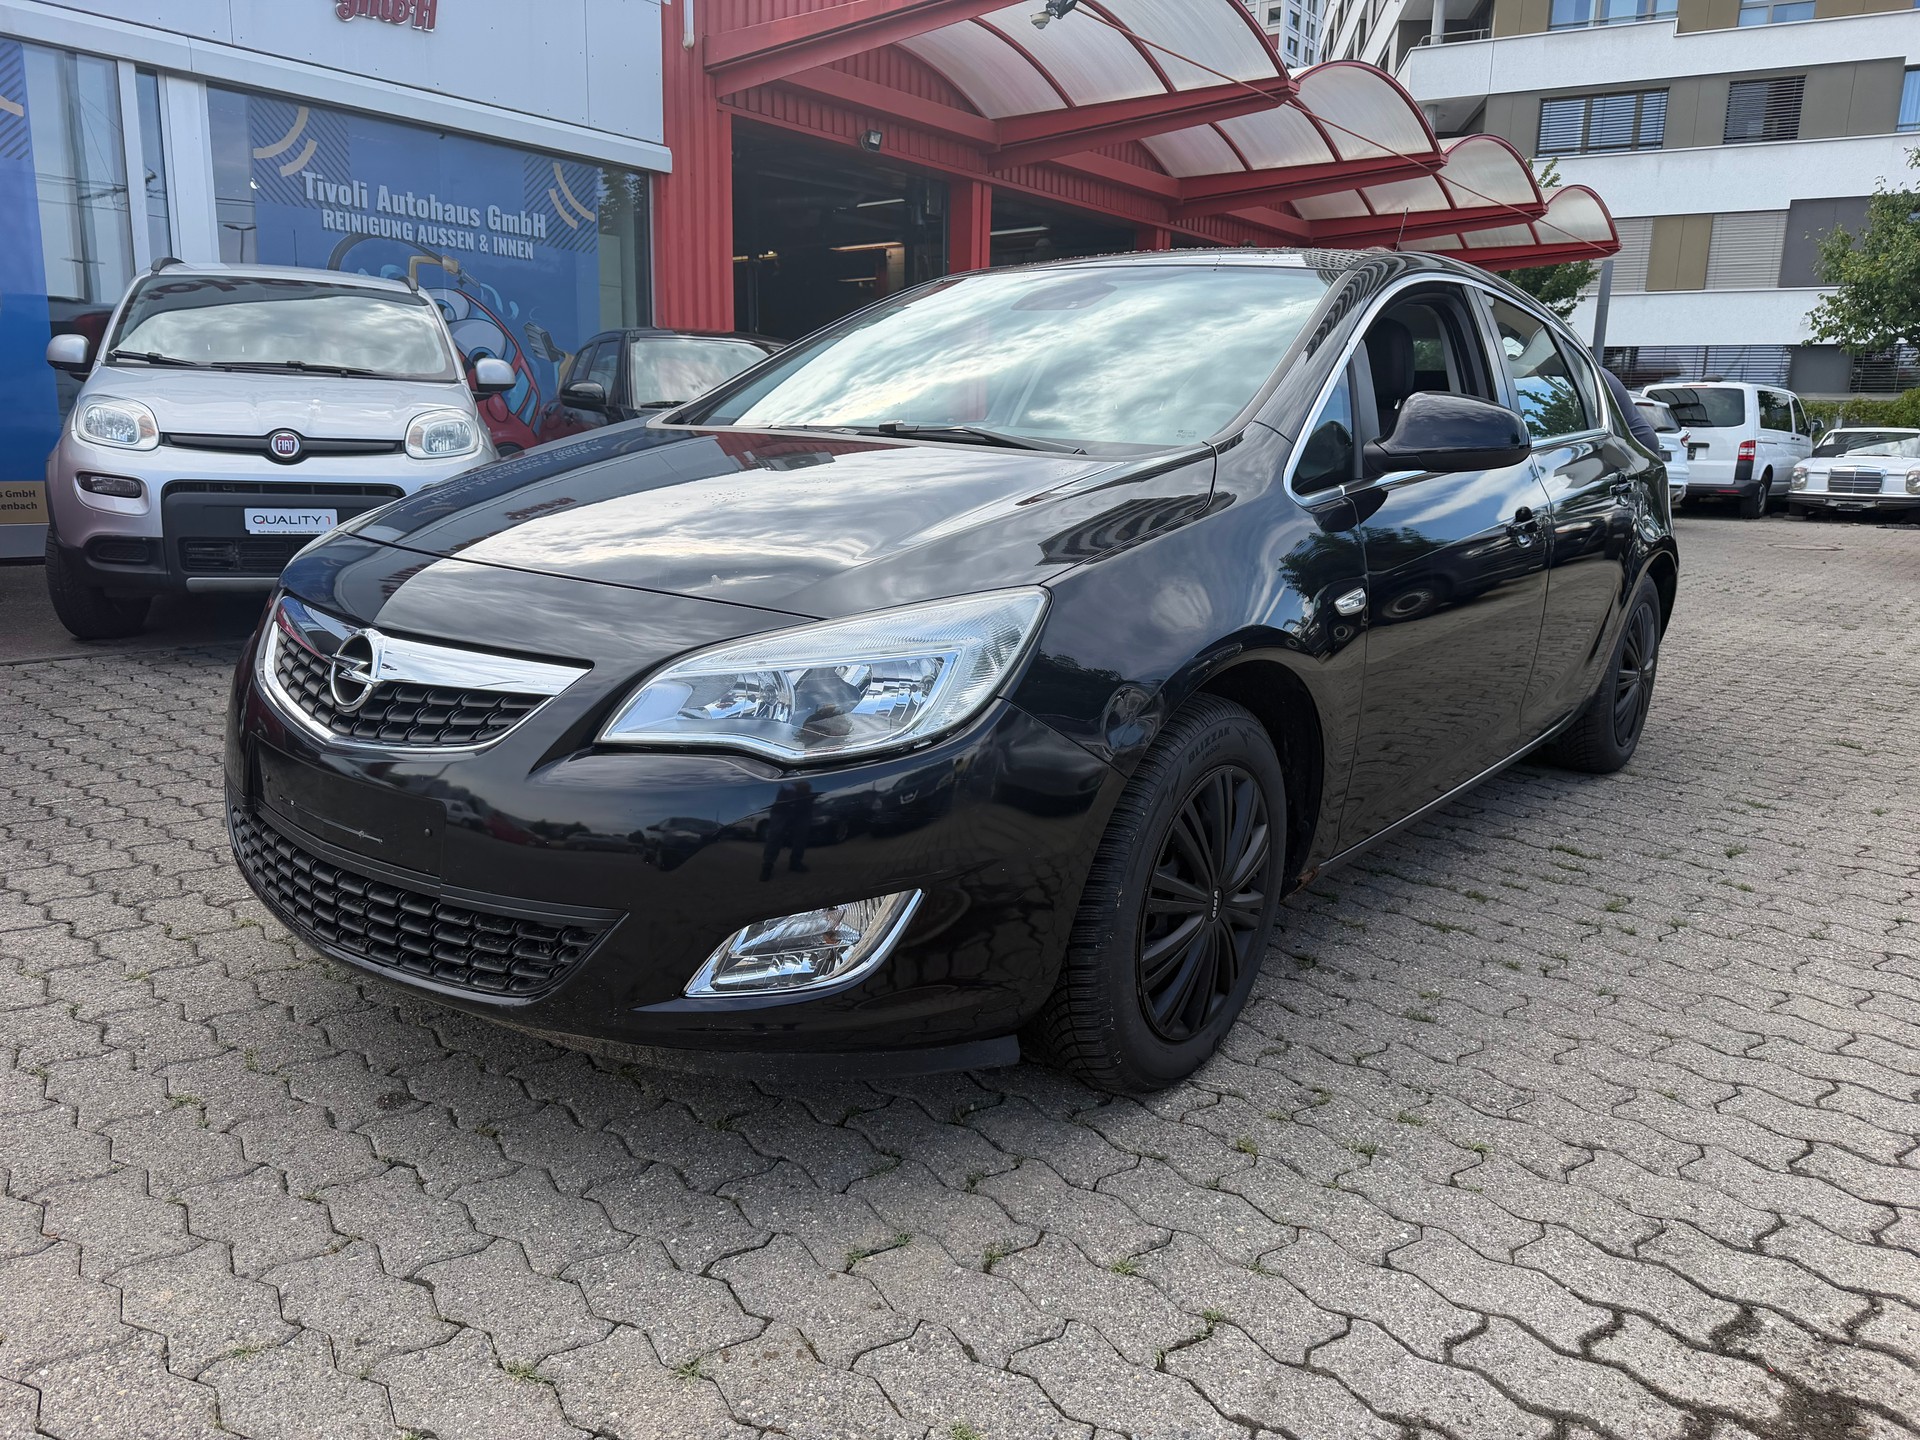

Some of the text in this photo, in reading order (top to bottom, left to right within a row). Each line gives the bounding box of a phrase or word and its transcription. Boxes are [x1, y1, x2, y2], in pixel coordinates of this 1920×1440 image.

[302, 171, 546, 239] Tivoli Autohaus GmbH
[322, 209, 534, 259] REINIGUNG AUSSEN & INNEN
[277, 440, 294, 451] FIAT
[5, 490, 36, 498] GmbH
[0, 502, 38, 510] enbach
[253, 515, 321, 525] QUALITY
[1189, 726, 1230, 764] BLIZZAK
